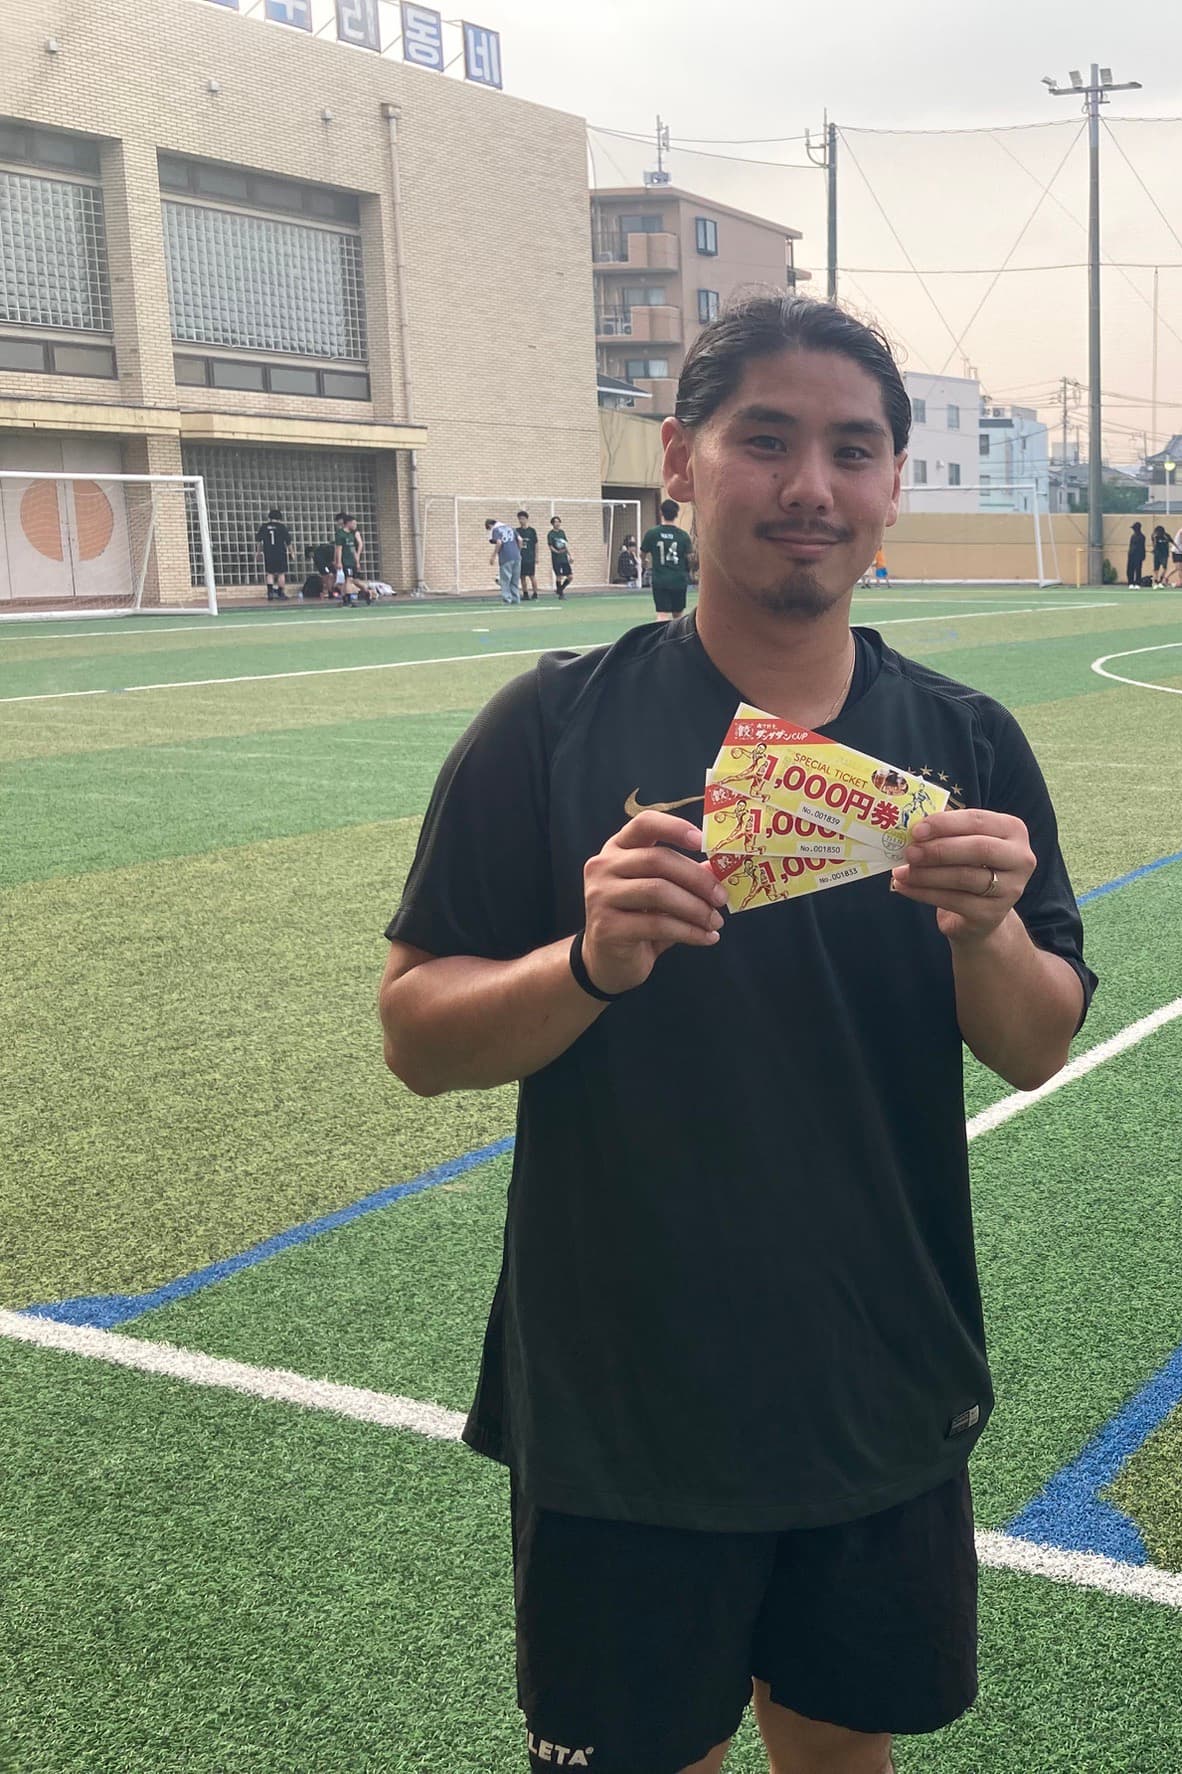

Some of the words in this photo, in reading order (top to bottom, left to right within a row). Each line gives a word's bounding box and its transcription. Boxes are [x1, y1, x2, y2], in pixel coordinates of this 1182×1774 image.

[656, 541, 679, 565] 14
[794, 752, 831, 775] SPECIAL
[835, 768, 868, 789] TICKET
[763, 754, 900, 830] 1,000円券
